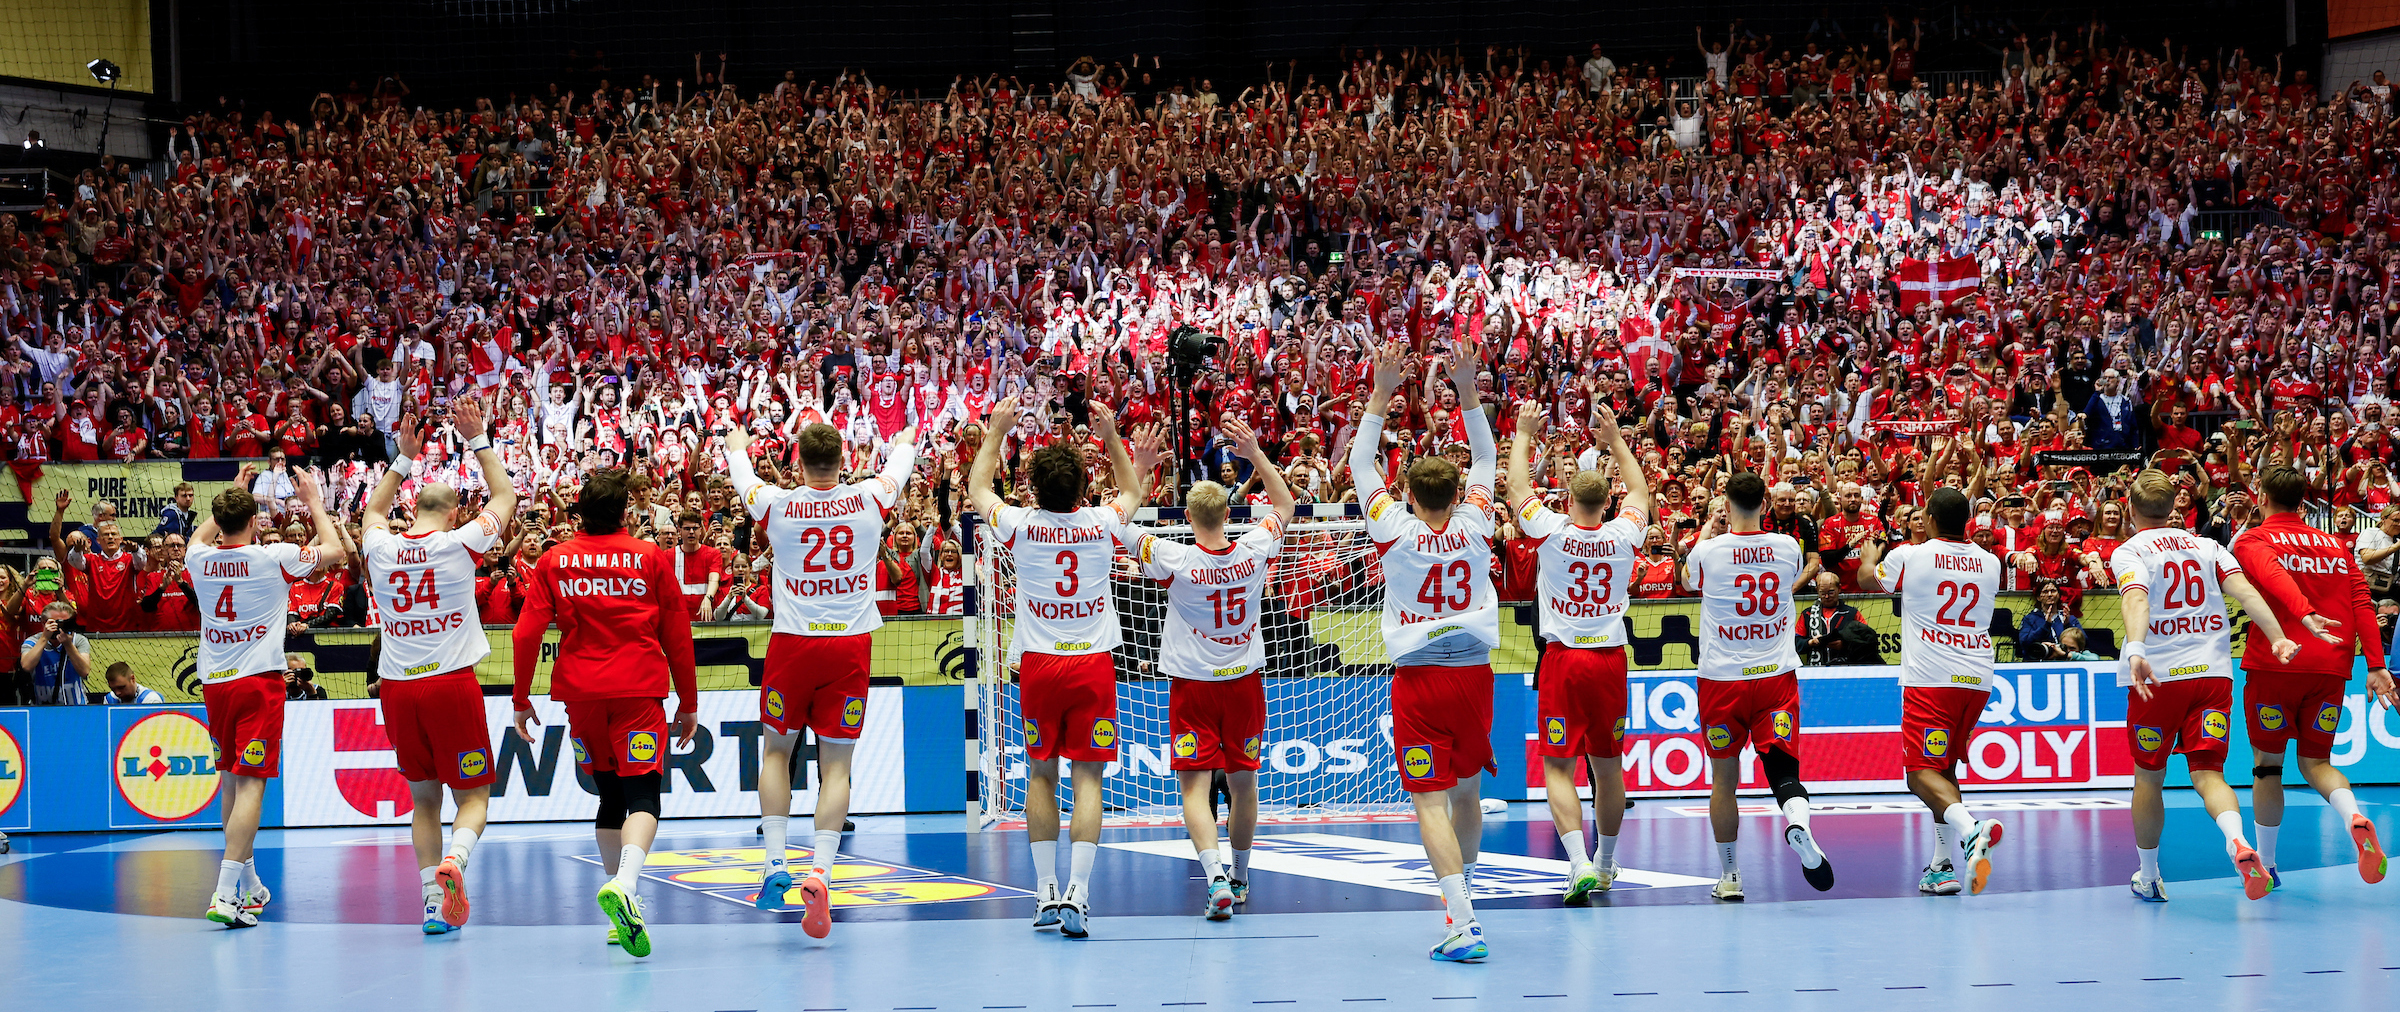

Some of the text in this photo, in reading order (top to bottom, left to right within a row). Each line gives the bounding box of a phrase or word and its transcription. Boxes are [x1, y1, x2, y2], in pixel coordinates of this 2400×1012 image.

[2099, 452, 2142, 461] SILKEBORG
[88, 477, 127, 498] PURE
[100, 497, 177, 518] REATNE
[785, 494, 865, 519] ANDERSSON
[1027, 525, 1104, 544] KIRKELØKKE
[1418, 529, 1470, 553] PYTLICK
[396, 547, 428, 565] HALD
[801, 525, 854, 573] 28
[1562, 537, 1616, 558] BERGHOLT
[1733, 546, 1775, 565] HOXER
[203, 560, 250, 578] LANDIN
[559, 552, 644, 570] DANMARK
[1934, 553, 1983, 573] MENSAH
[2278, 552, 2349, 575] NORLYS
[1055, 550, 1079, 598] 3
[1191, 558, 1256, 585] SAUGSTRUP
[388, 568, 441, 613] 34
[558, 577, 648, 598] NORLYS
[786, 574, 868, 597] NORLYS
[1417, 559, 1472, 613] 43
[1567, 561, 1613, 605] 33
[1639, 582, 1673, 593] NORLYS
[2163, 559, 2206, 610] 26
[214, 585, 238, 622] 4
[1734, 571, 1780, 617] 38
[299, 601, 329, 613] ORLS
[1029, 596, 1105, 620] NORLYS
[1206, 586, 1247, 630] 15
[1551, 597, 1622, 618] NORLYS
[1936, 580, 1980, 628] 22
[384, 611, 464, 637] NORLYS
[809, 622, 848, 632] BORUP
[1718, 616, 1788, 641] NORLYS
[2149, 614, 2224, 636] NORLYS
[1055, 641, 1091, 651] BORUP
[1574, 635, 1609, 644] BORUP
[1921, 628, 1992, 650] NORLYS
[542, 643, 560, 663] PU
[208, 667, 239, 679] BORUP
[404, 661, 441, 677] BORUP
[1213, 665, 1248, 677] BORUP
[1743, 664, 1779, 676] BORUP
[2169, 664, 2210, 676] BORUP
[1951, 674, 1983, 685] BORUP
[768, 698, 783, 710] LIDL
[1978, 673, 2081, 726] QUI
[846, 706, 862, 716] LIDL
[2260, 712, 2282, 722] LIDL
[1094, 727, 1114, 737] LIDL
[1548, 726, 1563, 735] LIDL
[2206, 718, 2227, 731] LIDL
[631, 740, 655, 751] LIDL
[1176, 740, 1195, 749] LIDL
[1708, 732, 1729, 741] LIDL
[1927, 737, 1947, 746] LIDL
[2138, 734, 2161, 742] LIDL
[245, 747, 264, 756] LIDL
[123, 745, 216, 782] LIDL
[462, 759, 485, 769] LIDL
[1406, 756, 1430, 767] LIDL
